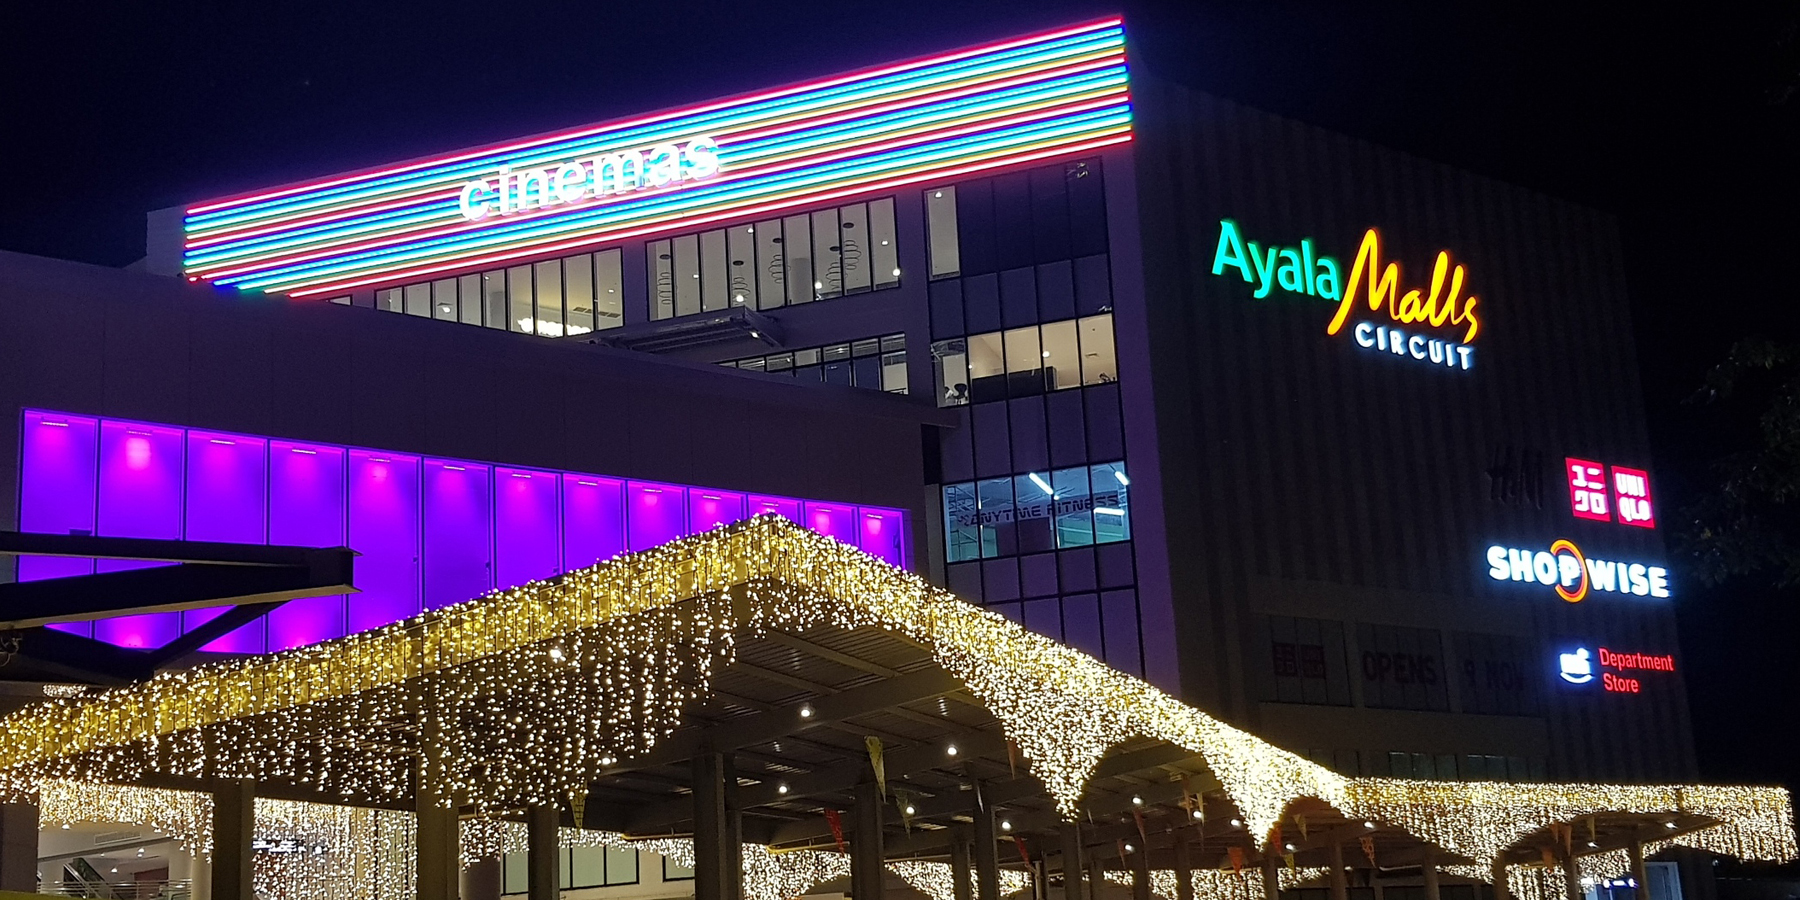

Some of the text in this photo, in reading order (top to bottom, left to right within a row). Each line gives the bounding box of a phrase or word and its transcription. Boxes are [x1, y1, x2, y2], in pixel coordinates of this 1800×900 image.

[459, 136, 719, 221] cinemas
[1212, 220, 1479, 343] Ayala Malls
[1355, 322, 1474, 370] CIRCUIT
[1615, 472, 1647, 497] UNI
[969, 504, 1042, 526] ANYTME
[1486, 545, 1670, 598] SHOPWISE
[1362, 651, 1438, 685] OPENS
[1598, 647, 1675, 672] Department
[1602, 672, 1640, 693] Store
